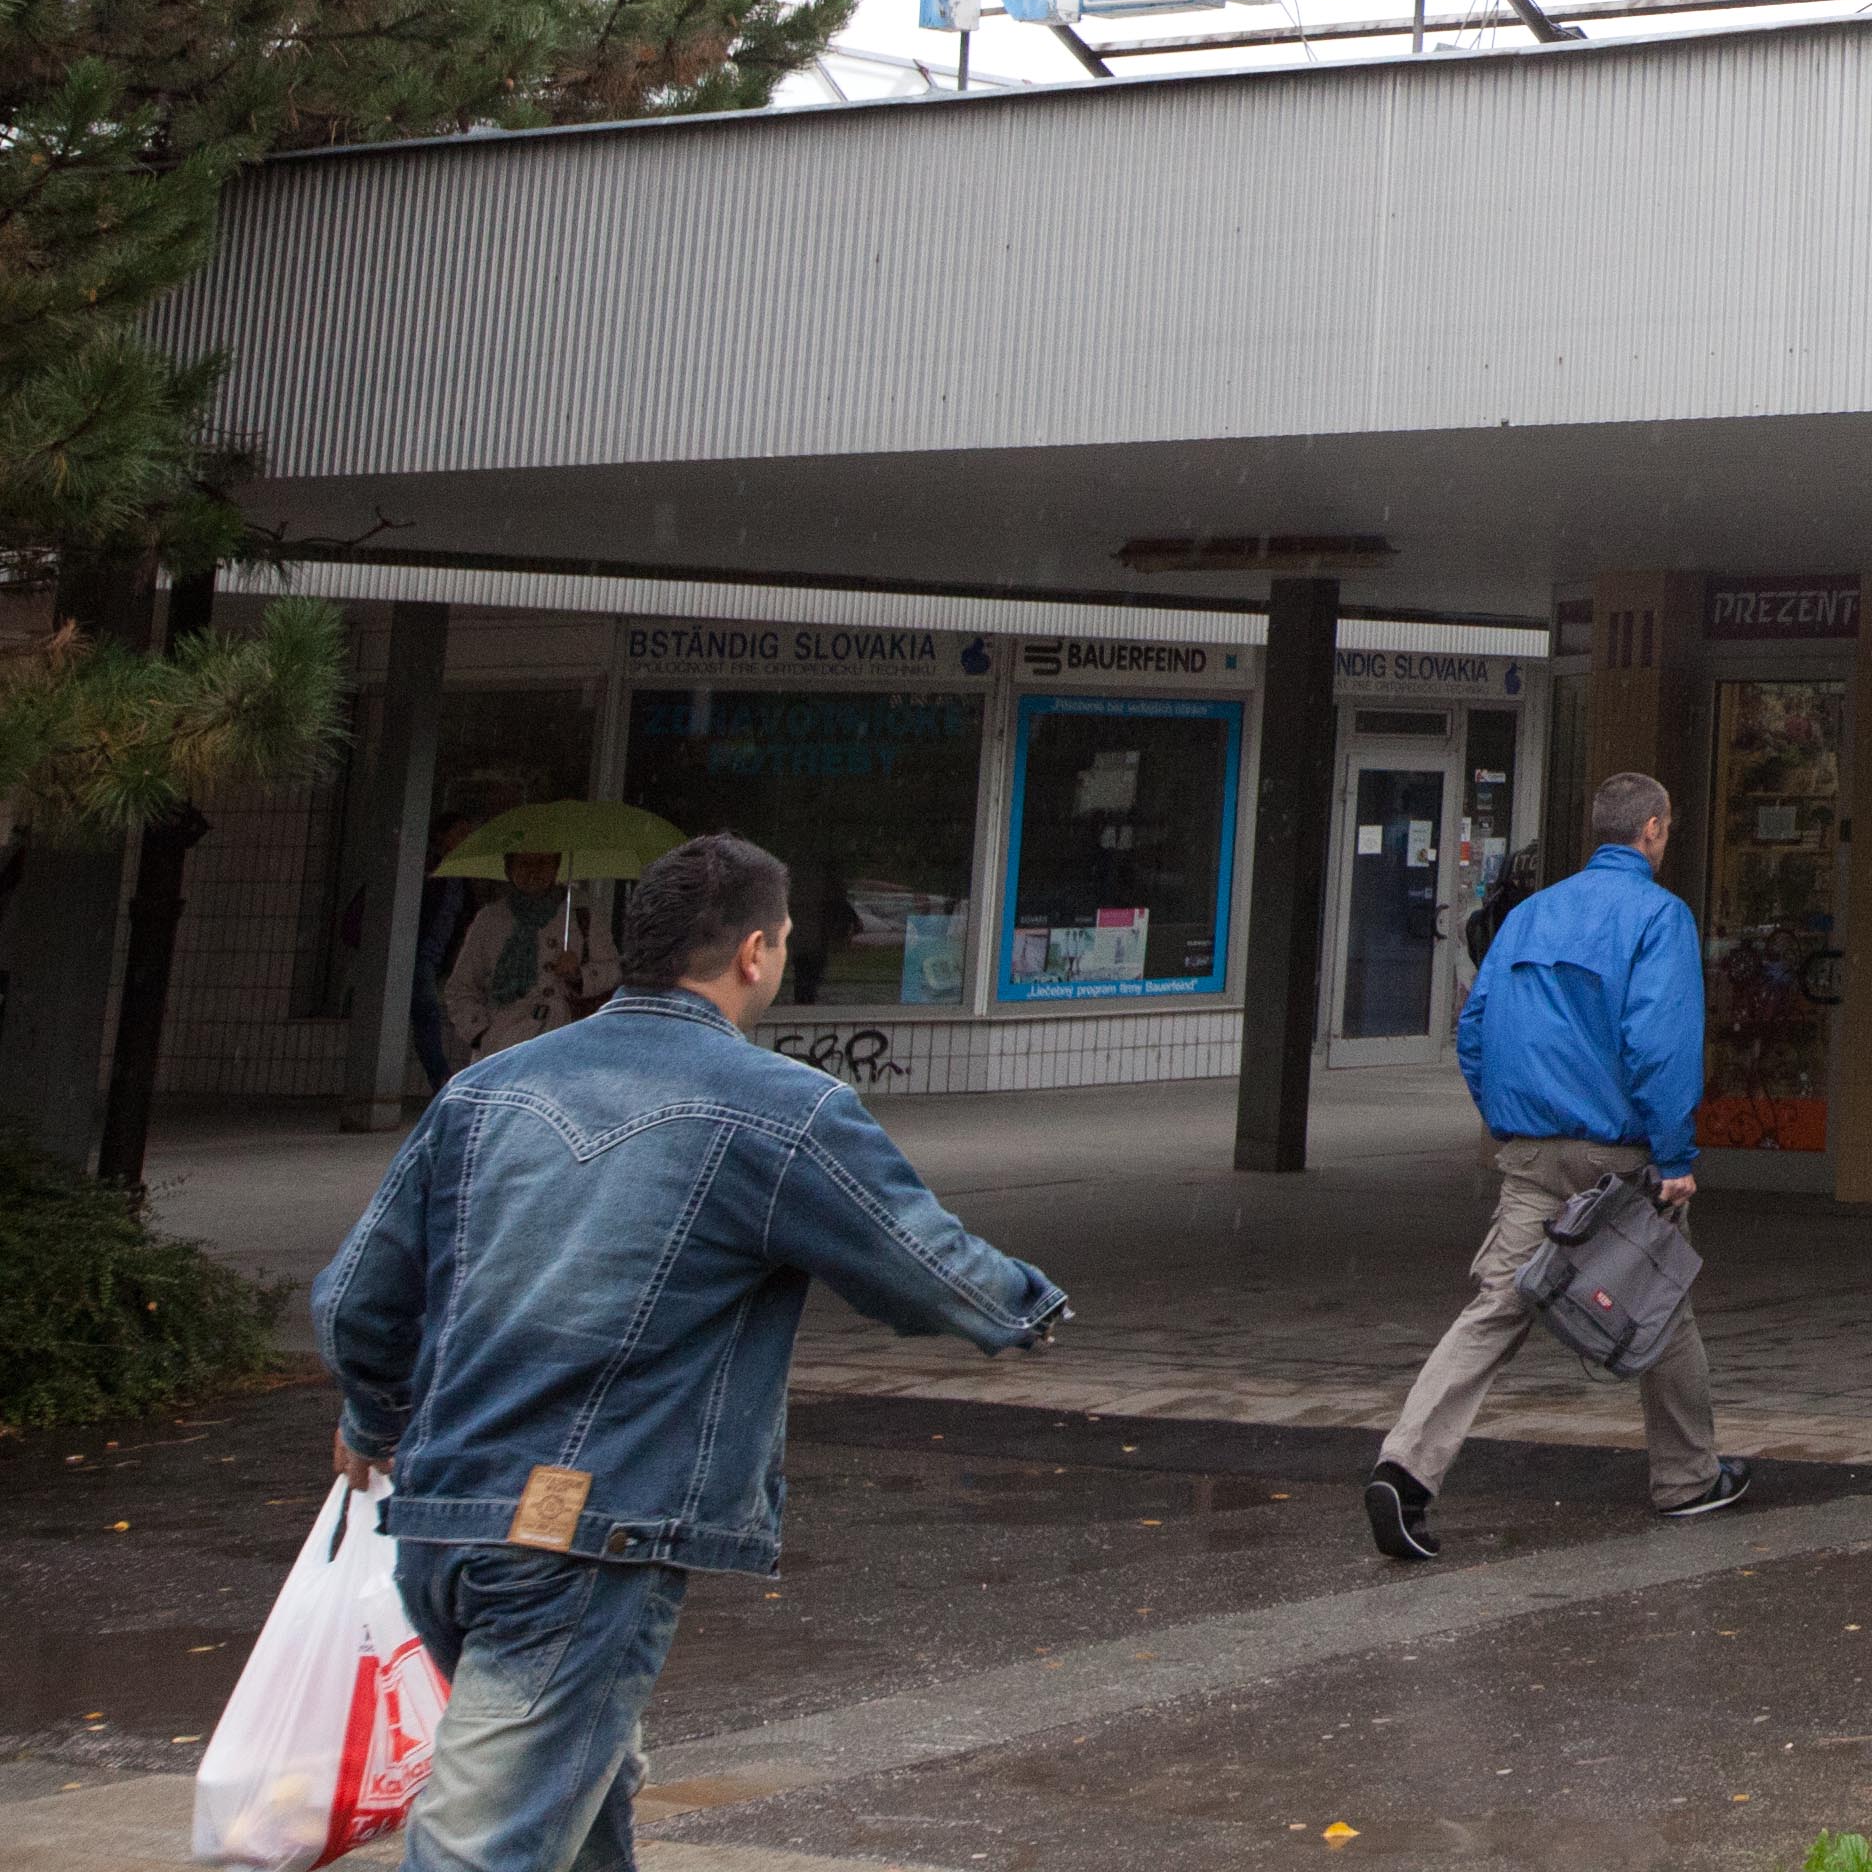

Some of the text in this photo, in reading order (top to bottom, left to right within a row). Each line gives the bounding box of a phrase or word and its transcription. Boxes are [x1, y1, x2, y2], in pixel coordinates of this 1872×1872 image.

[1713, 590, 1860, 626] PREZENT
[628, 626, 936, 660] BSTÄNDIG SLOVAKIA
[1067, 642, 1207, 674] BAUERFEIND
[1394, 654, 1488, 682] SLOVAKIA
